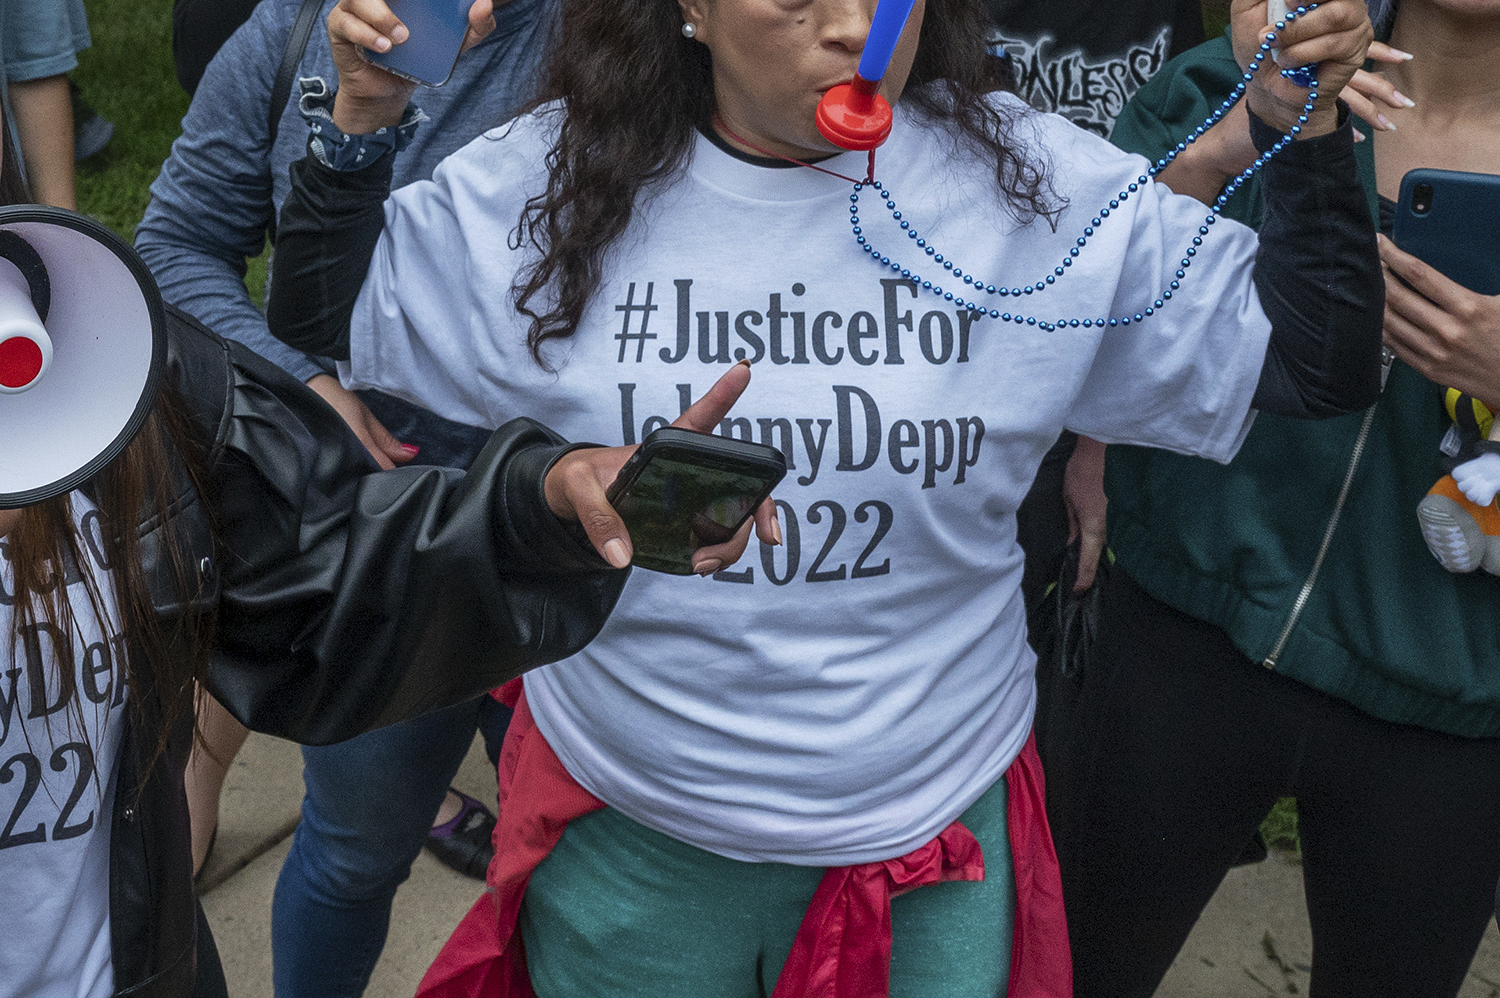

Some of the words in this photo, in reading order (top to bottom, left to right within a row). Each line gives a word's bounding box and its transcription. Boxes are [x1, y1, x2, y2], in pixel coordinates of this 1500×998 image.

[614, 278, 981, 366] #JusticeFor
[617, 383, 986, 490] JnyDepp
[712, 499, 894, 587] 022
